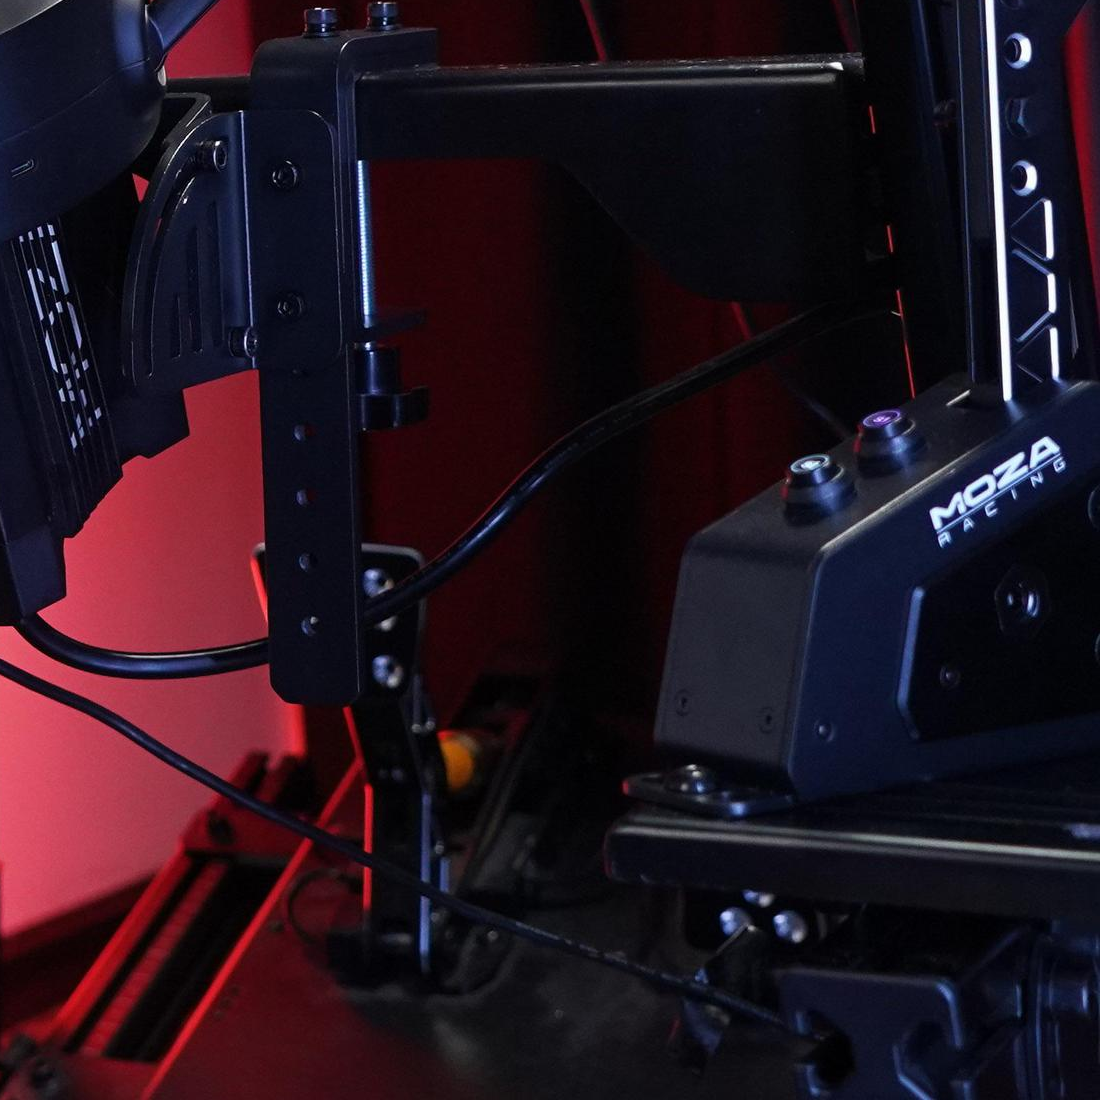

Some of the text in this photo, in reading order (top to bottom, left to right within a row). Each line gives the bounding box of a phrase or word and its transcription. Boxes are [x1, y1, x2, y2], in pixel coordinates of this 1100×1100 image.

[18, 223, 102, 450] MOZ
[929, 436, 1061, 531] MOZA
[937, 456, 1066, 548] RACING
